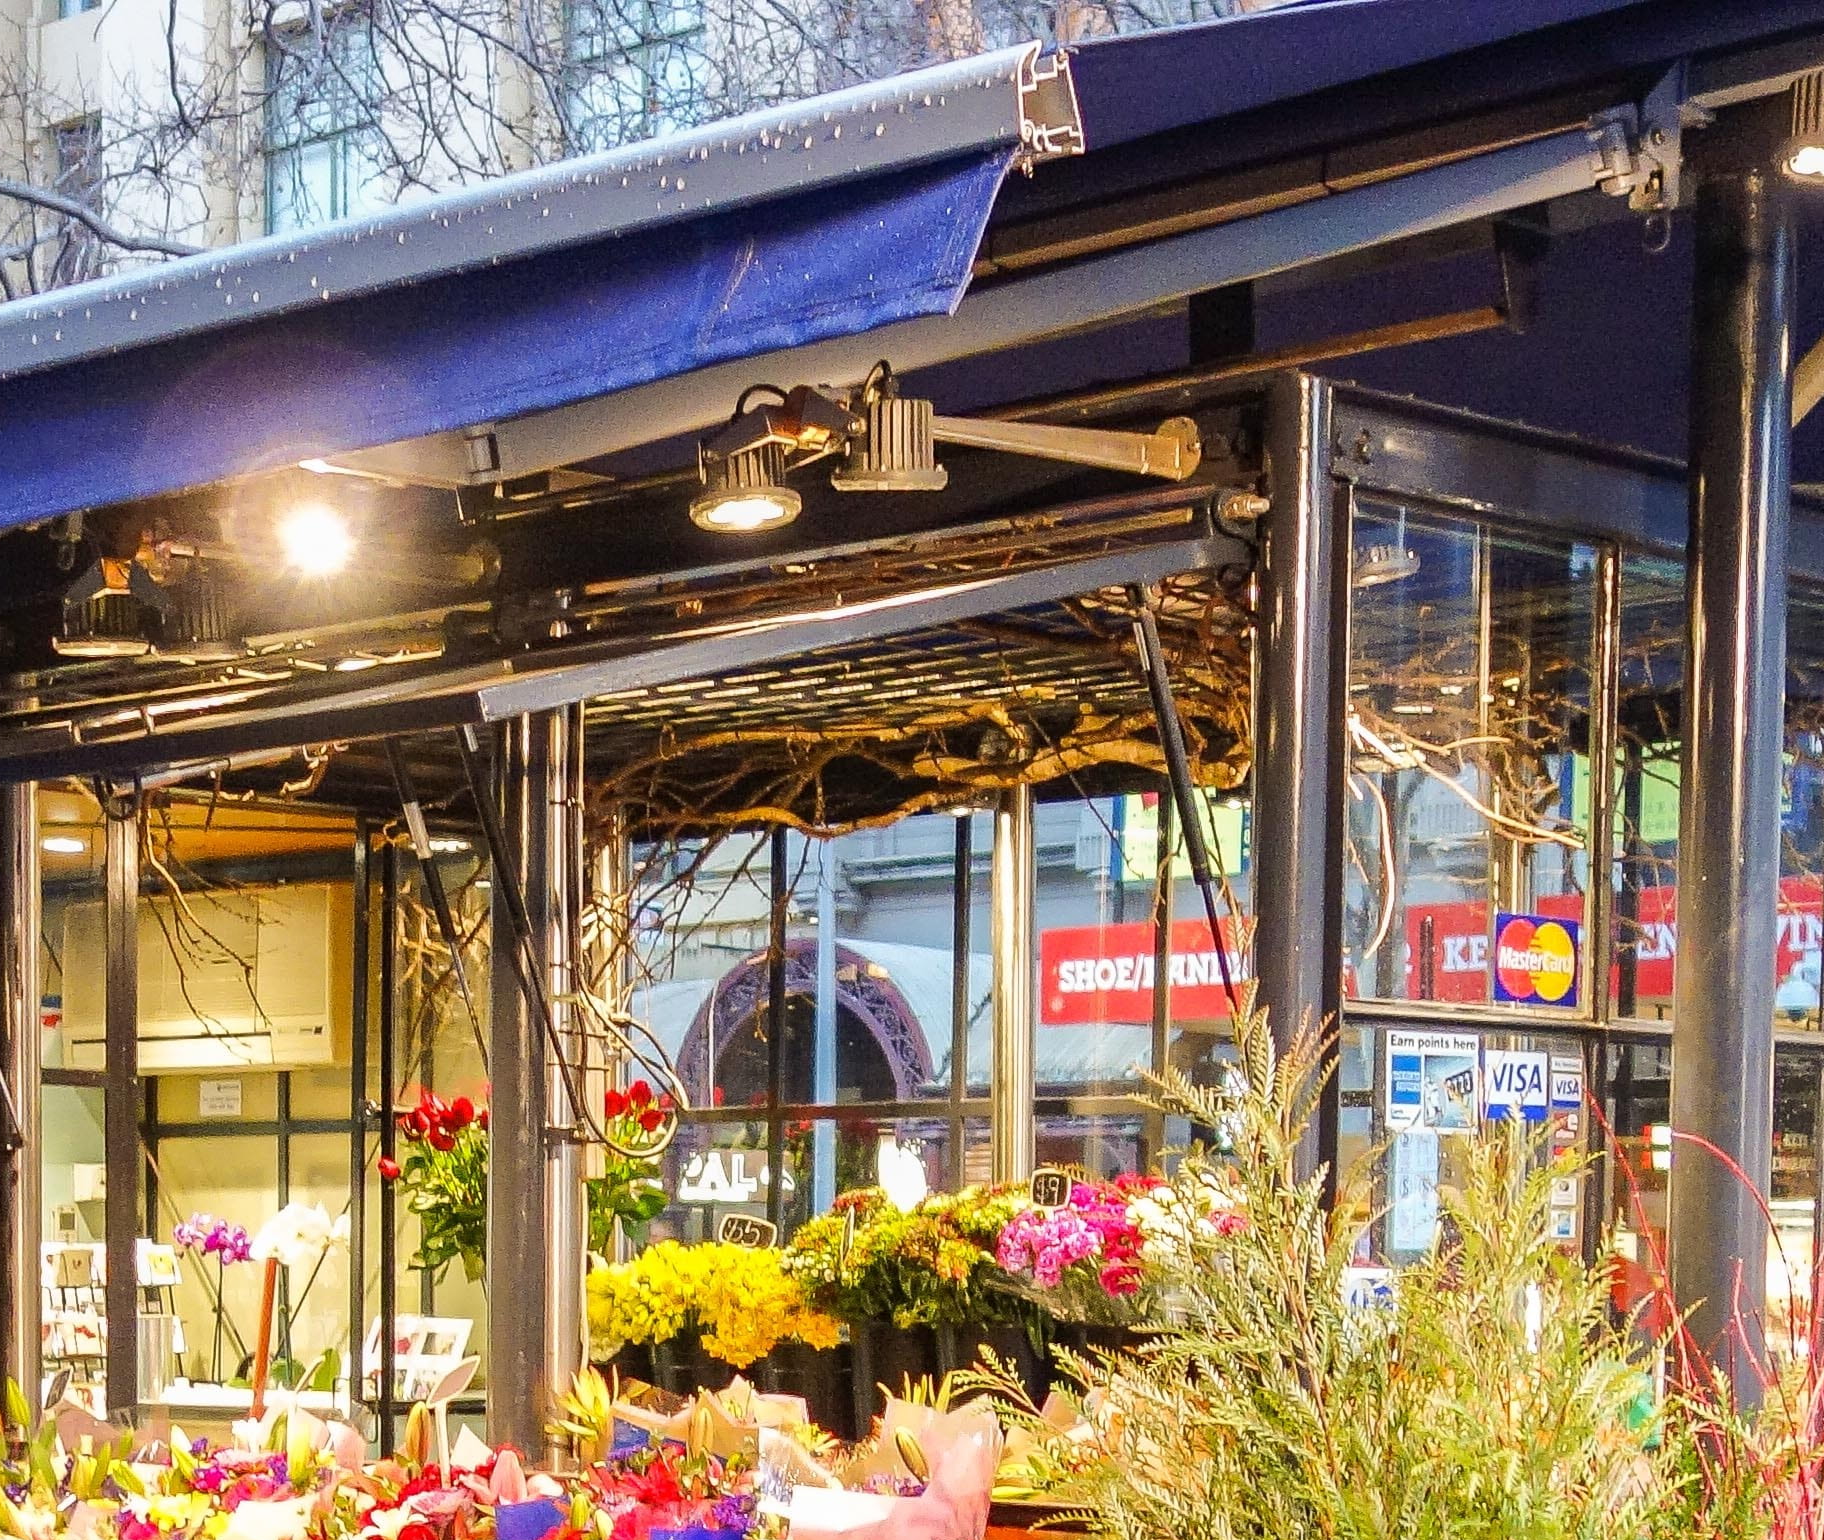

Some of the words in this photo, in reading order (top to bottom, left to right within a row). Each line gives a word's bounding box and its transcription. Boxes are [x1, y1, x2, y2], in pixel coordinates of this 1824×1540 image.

[1390, 1034, 1415, 1047] Earn
[1418, 1035, 1450, 1050] points
[1453, 1037, 1476, 1051] here
[1492, 1062, 1543, 1094] VISA
[1556, 1077, 1579, 1096] VISA
